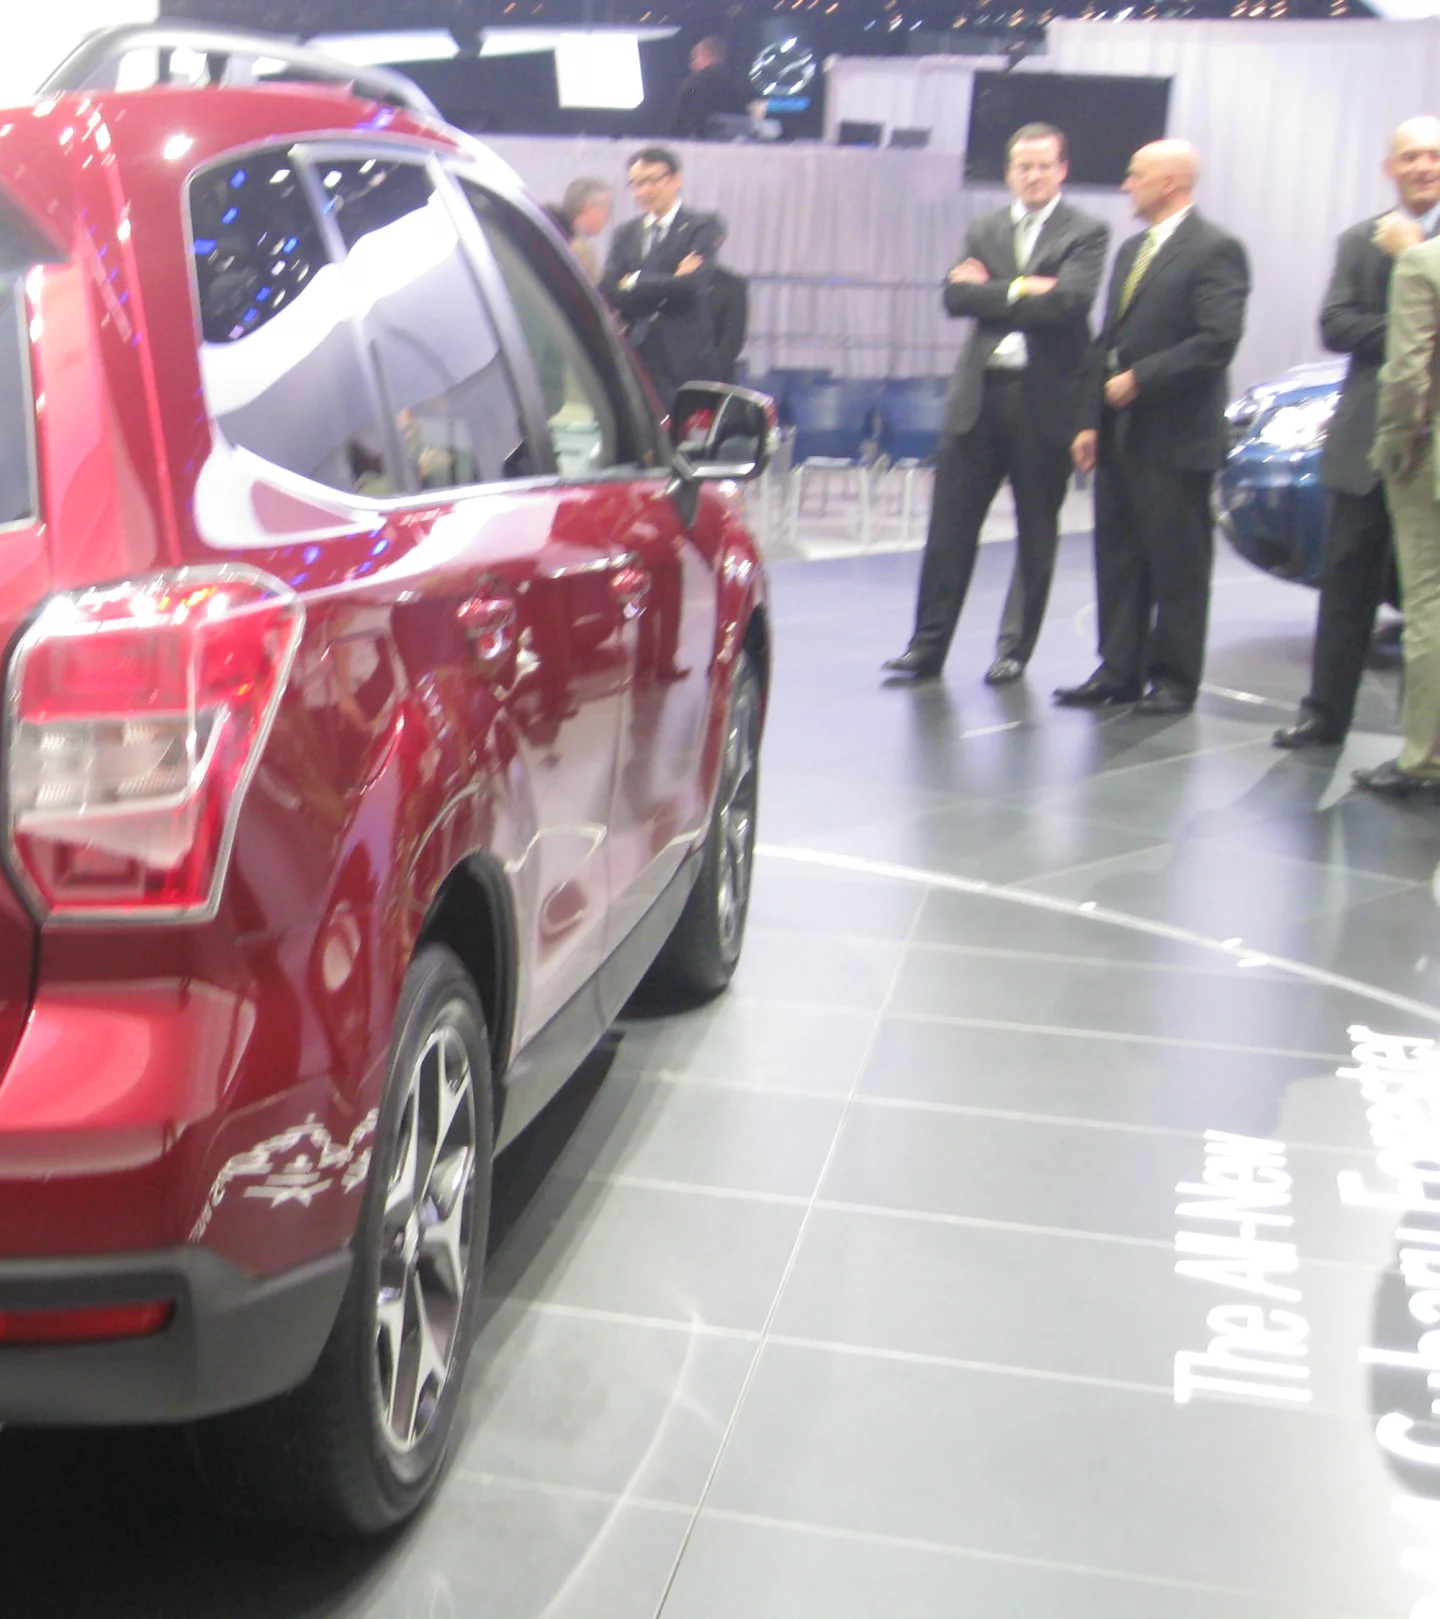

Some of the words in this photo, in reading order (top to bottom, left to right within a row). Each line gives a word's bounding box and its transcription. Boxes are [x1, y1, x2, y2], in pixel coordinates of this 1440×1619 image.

[1173, 1128, 1303, 1303] All-New
[1173, 1304, 1314, 1406] The
[1357, 1227, 1440, 1467] bru
